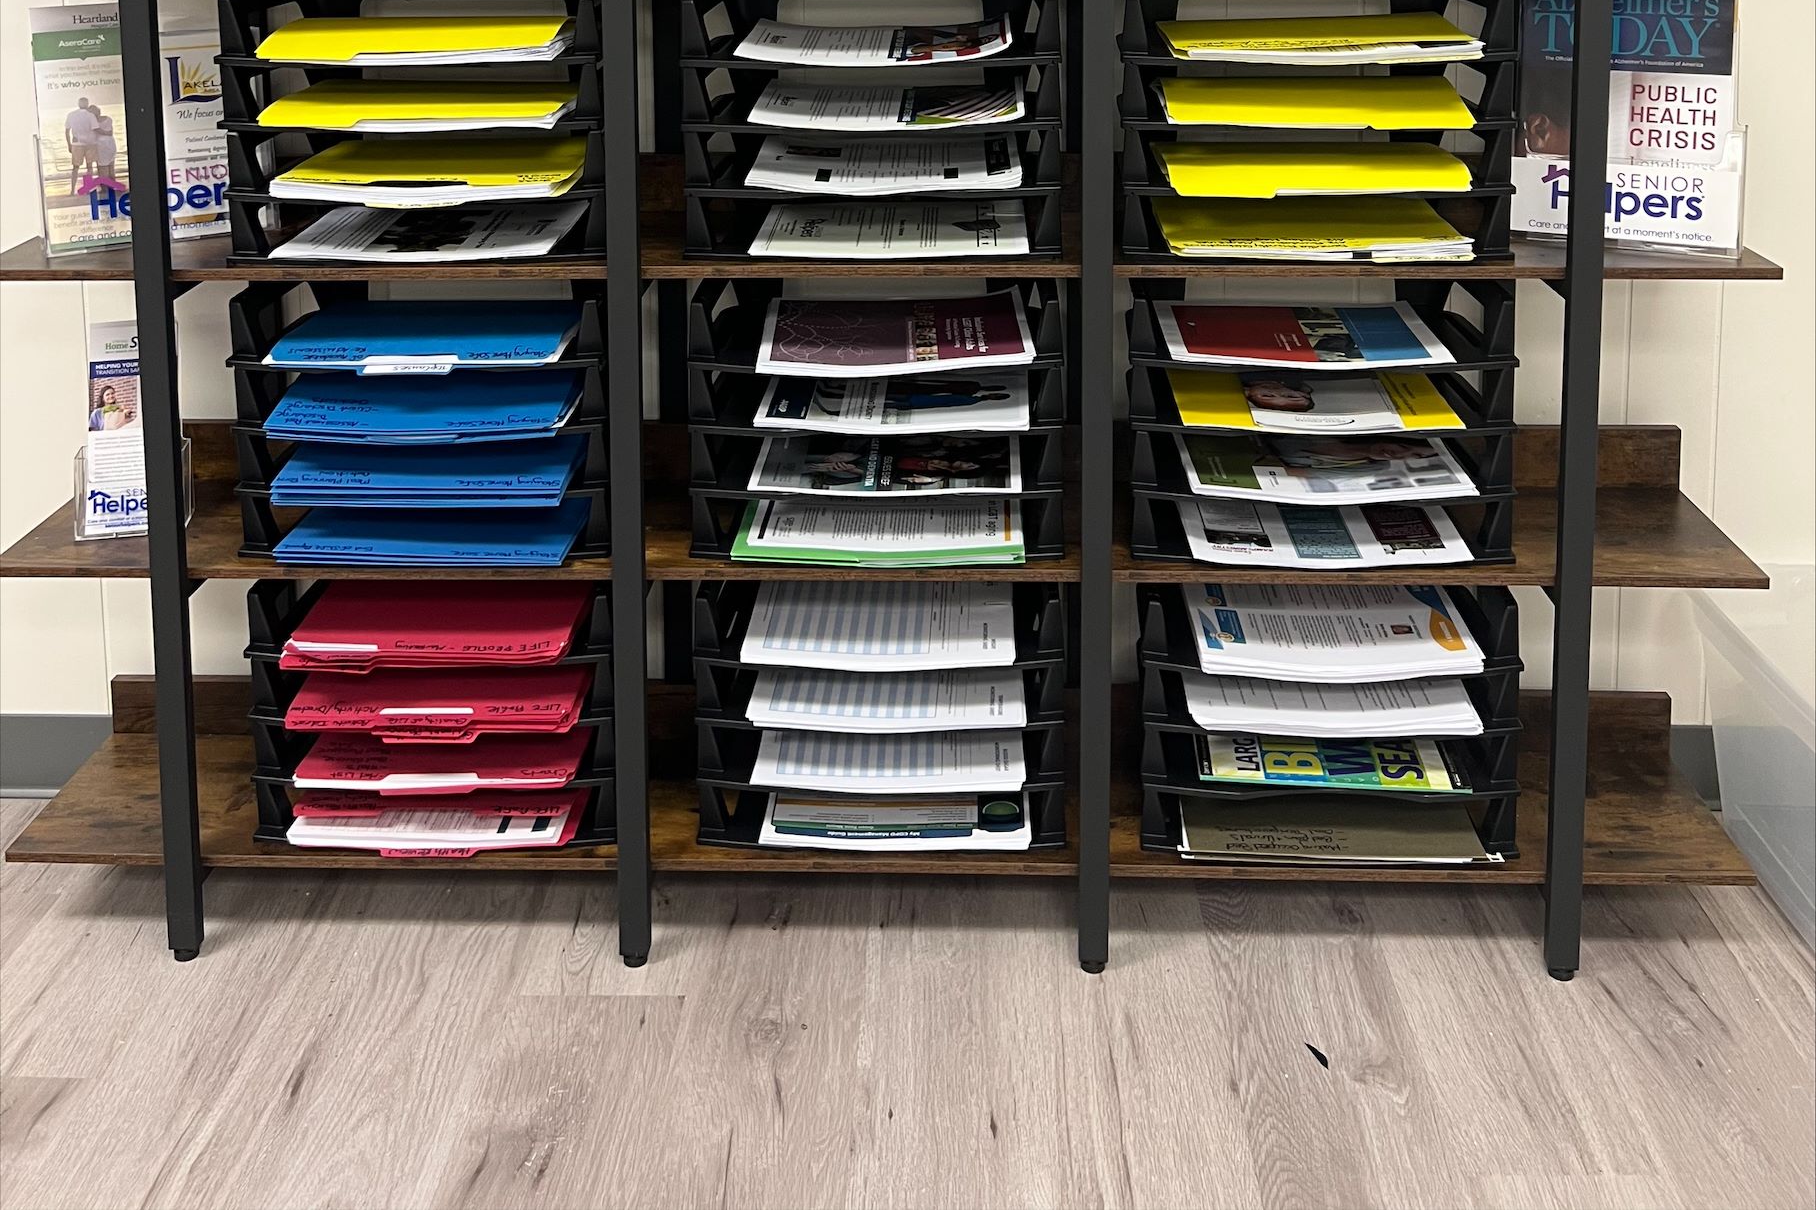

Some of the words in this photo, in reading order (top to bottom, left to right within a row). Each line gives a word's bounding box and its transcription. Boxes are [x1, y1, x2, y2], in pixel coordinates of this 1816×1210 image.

[73, 12, 119, 25] Heartland
[1532, 11, 1719, 59] TDAY
[58, 37, 102, 48] AseraCare
[1614, 58, 1644, 67] Alzheimer's
[1645, 59, 1674, 67] Foundation
[47, 80, 60, 90] It's
[60, 79, 81, 89] who
[82, 79, 99, 89] you
[99, 77, 121, 86] have
[1632, 84, 1718, 104] PUBLIC
[177, 108, 193, 120] We
[194, 108, 215, 122] focus
[1630, 106, 1717, 127] HEALTH
[1629, 128, 1716, 151] CRISIS
[1616, 172, 1704, 194] SENIOR
[1528, 219, 1551, 229] Care
[69, 232, 96, 243] Care
[98, 230, 116, 240] and
[1611, 225, 1622, 236] at
[1624, 227, 1631, 236] a
[1633, 227, 1680, 239] moment's
[1681, 231, 1713, 243] notice.
[105, 342, 128, 350] Home
[95, 368, 130, 376] TRANSITION
[864, 461, 877, 487] DEMENTIA
[984, 520, 998, 537] aging
[462, 644, 513, 652] PROFILE
[519, 640, 551, 651] LIFE
[532, 703, 562, 711] LIFE
[384, 717, 410, 725] Life
[388, 848, 432, 857] Review
[436, 847, 471, 857] Health
